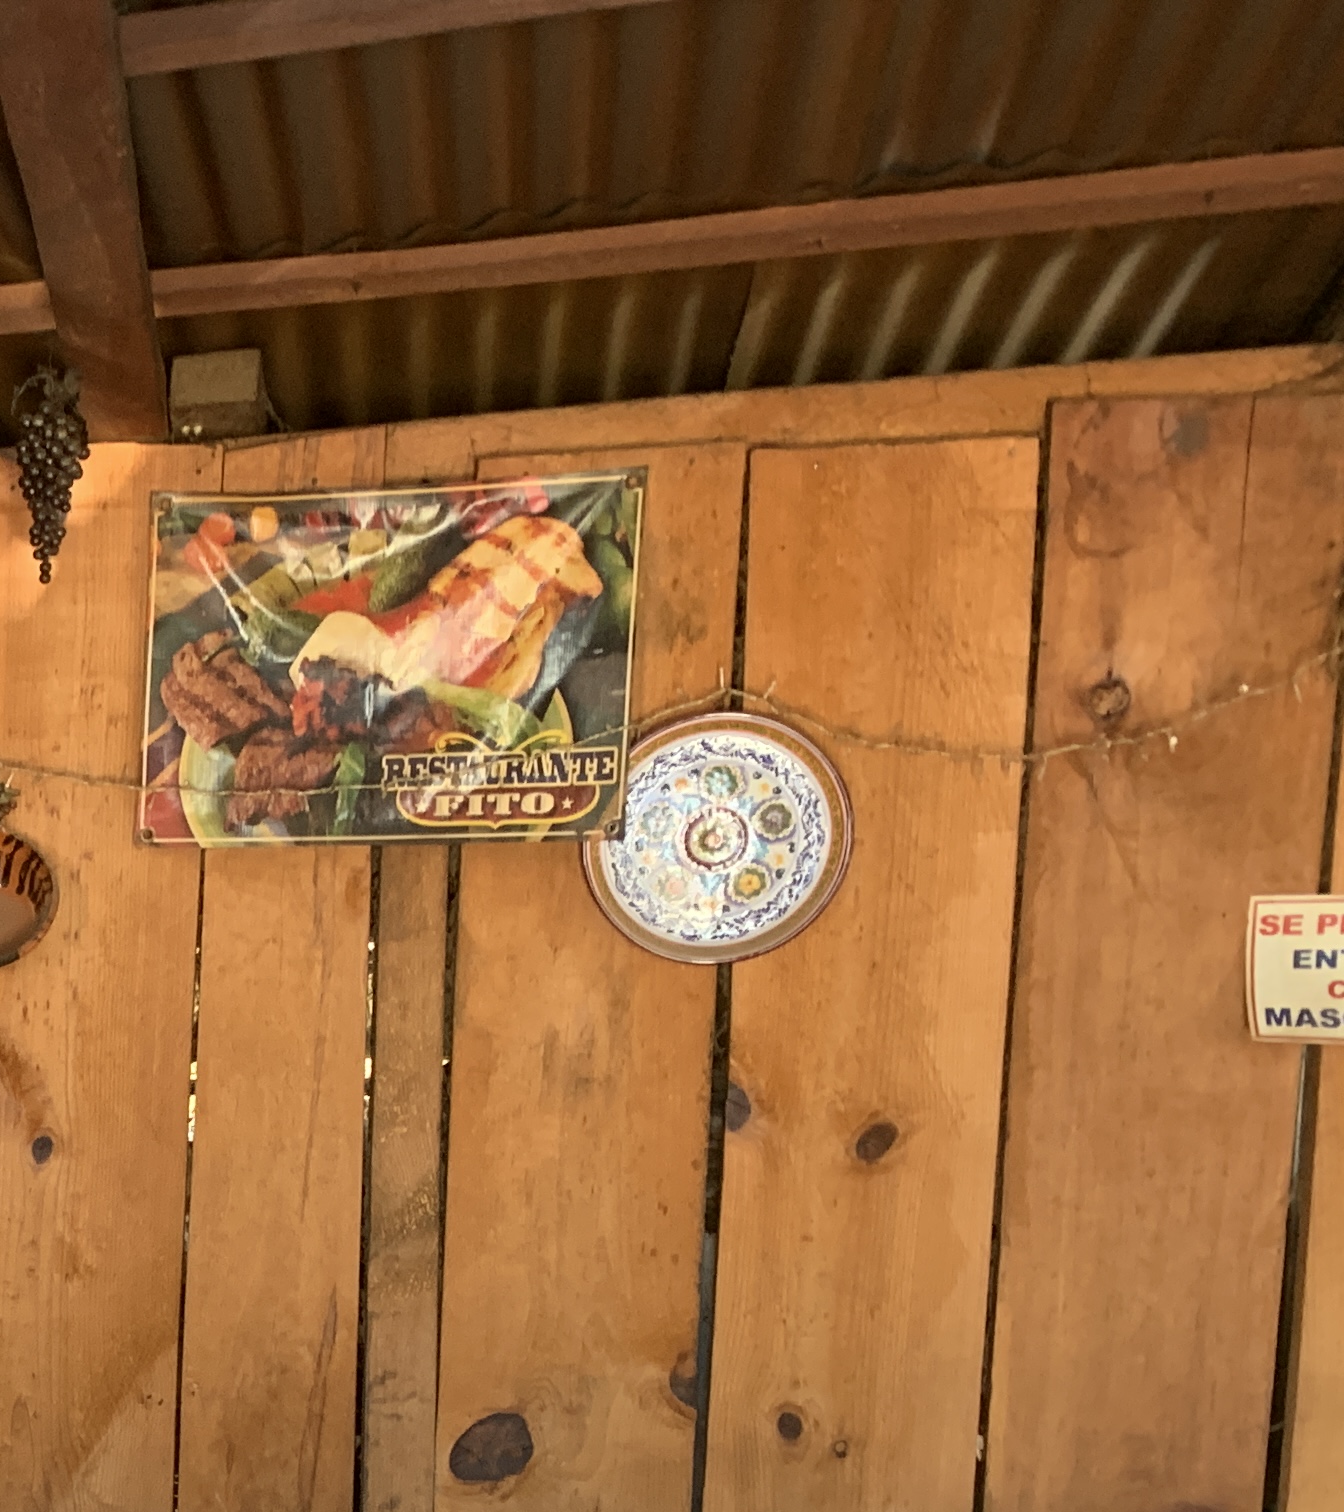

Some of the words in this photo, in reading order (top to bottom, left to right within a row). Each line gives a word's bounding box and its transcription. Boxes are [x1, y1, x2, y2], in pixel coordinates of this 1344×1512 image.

[433, 792, 555, 817] FITO
[1259, 914, 1303, 936] SE
[1317, 914, 1344, 935] P
[1293, 949, 1344, 969] EN
[1264, 1007, 1344, 1028] MAS
